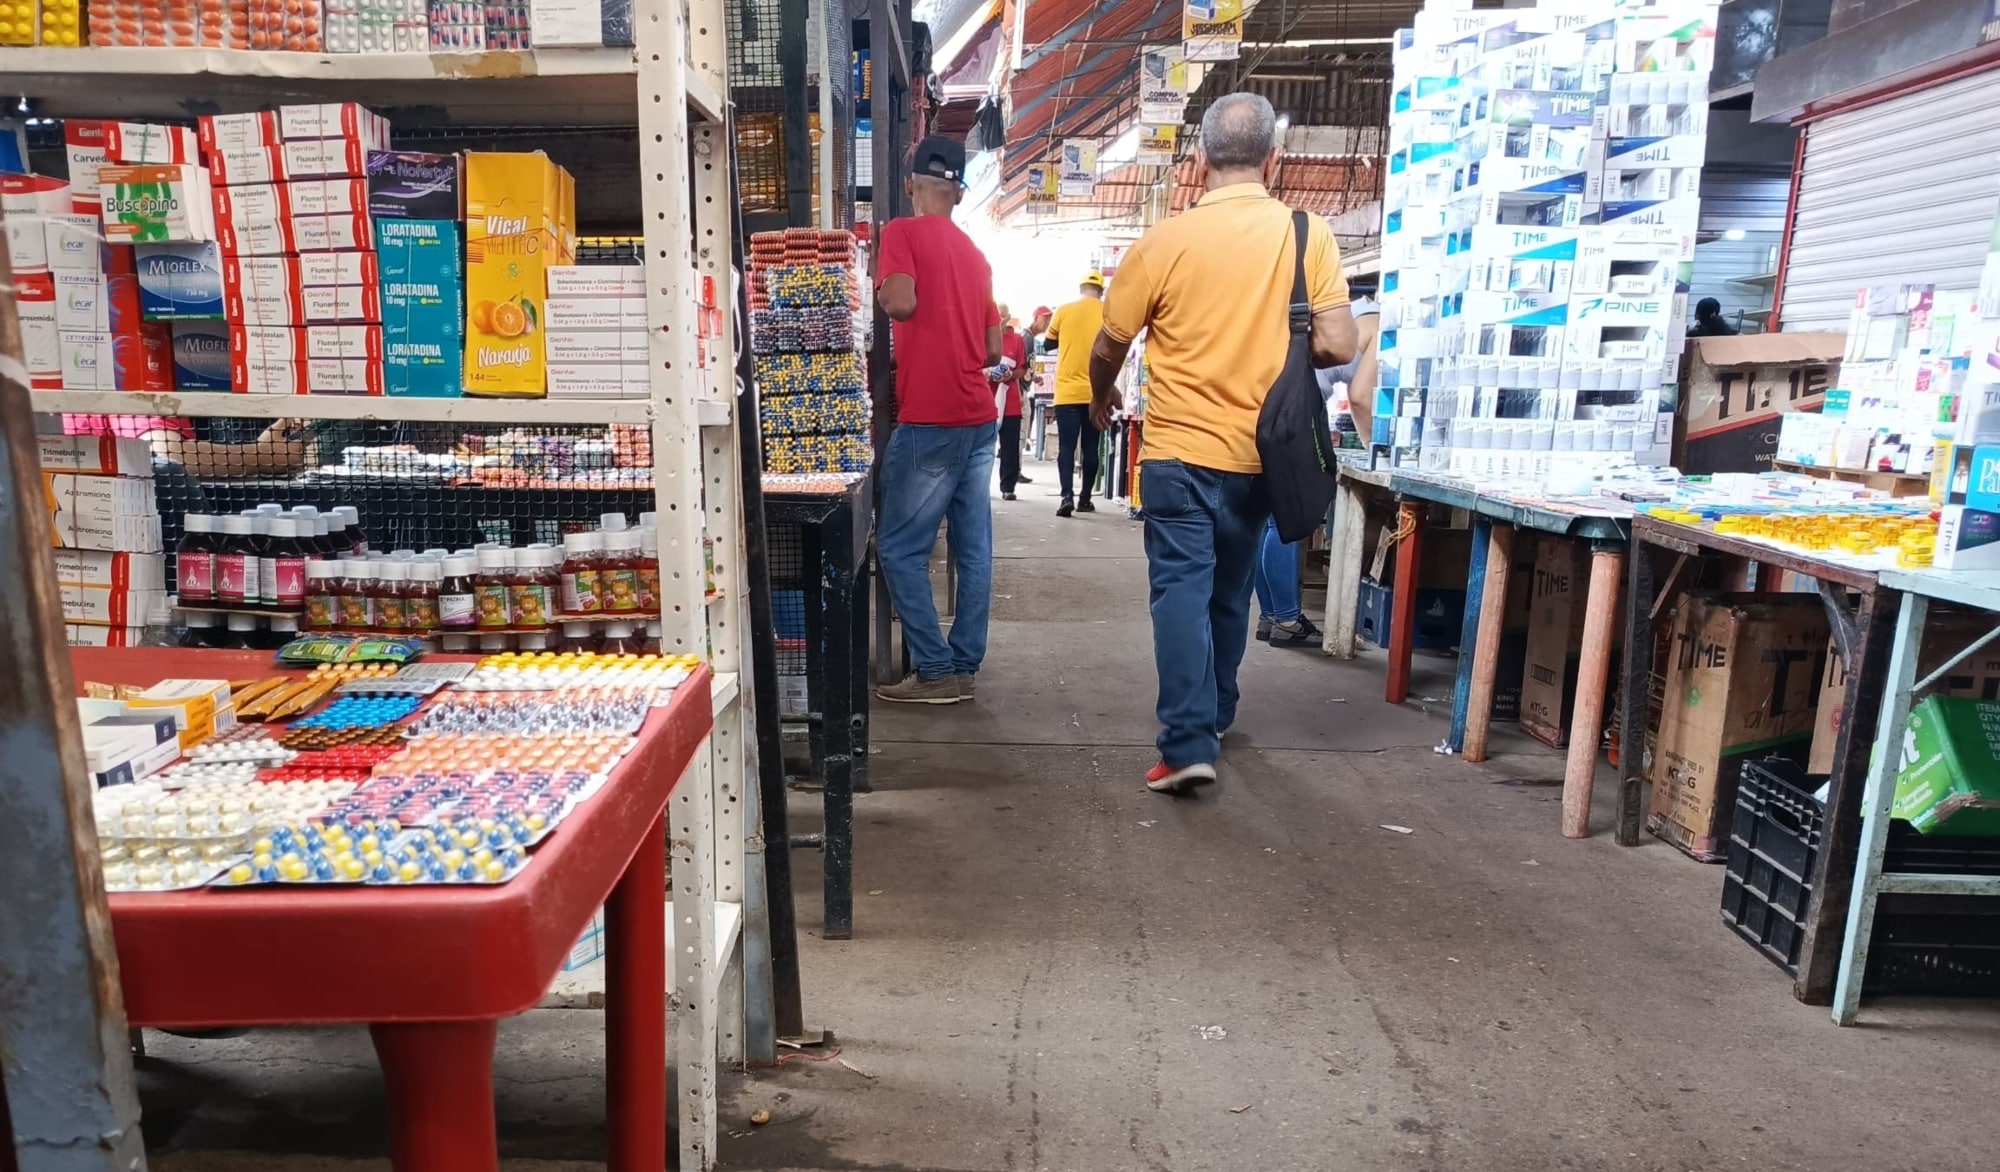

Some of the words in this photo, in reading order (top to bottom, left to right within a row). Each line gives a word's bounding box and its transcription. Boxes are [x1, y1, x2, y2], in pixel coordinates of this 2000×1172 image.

[1453, 16, 1489, 33] TIME
[1554, 14, 1588, 31] TIME
[1550, 97, 1591, 117] TIME
[290, 118, 328, 126] Flunarizna
[1635, 146, 1671, 162] TIME
[1520, 164, 1558, 181] TIME
[106, 197, 178, 214] Buscapina
[487, 215, 528, 235] Vical
[1630, 210, 1665, 225] TIME
[238, 224, 272, 232] Alpazolam
[381, 223, 438, 238] LORATADINA
[66, 240, 84, 249] ecar
[382, 236, 391, 246] 10
[390, 238, 404, 248] mg
[1512, 231, 1548, 247] TIME
[148, 260, 206, 276] MIOFLEX
[186, 288, 198, 296] 750
[384, 283, 440, 297] LORATADINA
[386, 296, 394, 305] 10
[394, 297, 406, 307] mg
[1502, 297, 1539, 313] TIME
[1604, 302, 1660, 313] PINE
[18, 313, 55, 322] urosemida
[65, 334, 104, 342] CETIRIZINA
[184, 338, 231, 354] MIOFLE
[387, 343, 442, 357] LORATADINA
[388, 356, 396, 364] 10
[396, 356, 408, 366] mg
[478, 344, 532, 369] Naranja
[317, 372, 354, 380] Flunarizna
[470, 372, 485, 382] 144
[64, 489, 112, 499] Aztromicina
[1944, 518, 1955, 552] TIME
[1536, 569, 1569, 598] TIME
[1676, 632, 1726, 671] TIME
[1667, 765, 1697, 789] KTG
